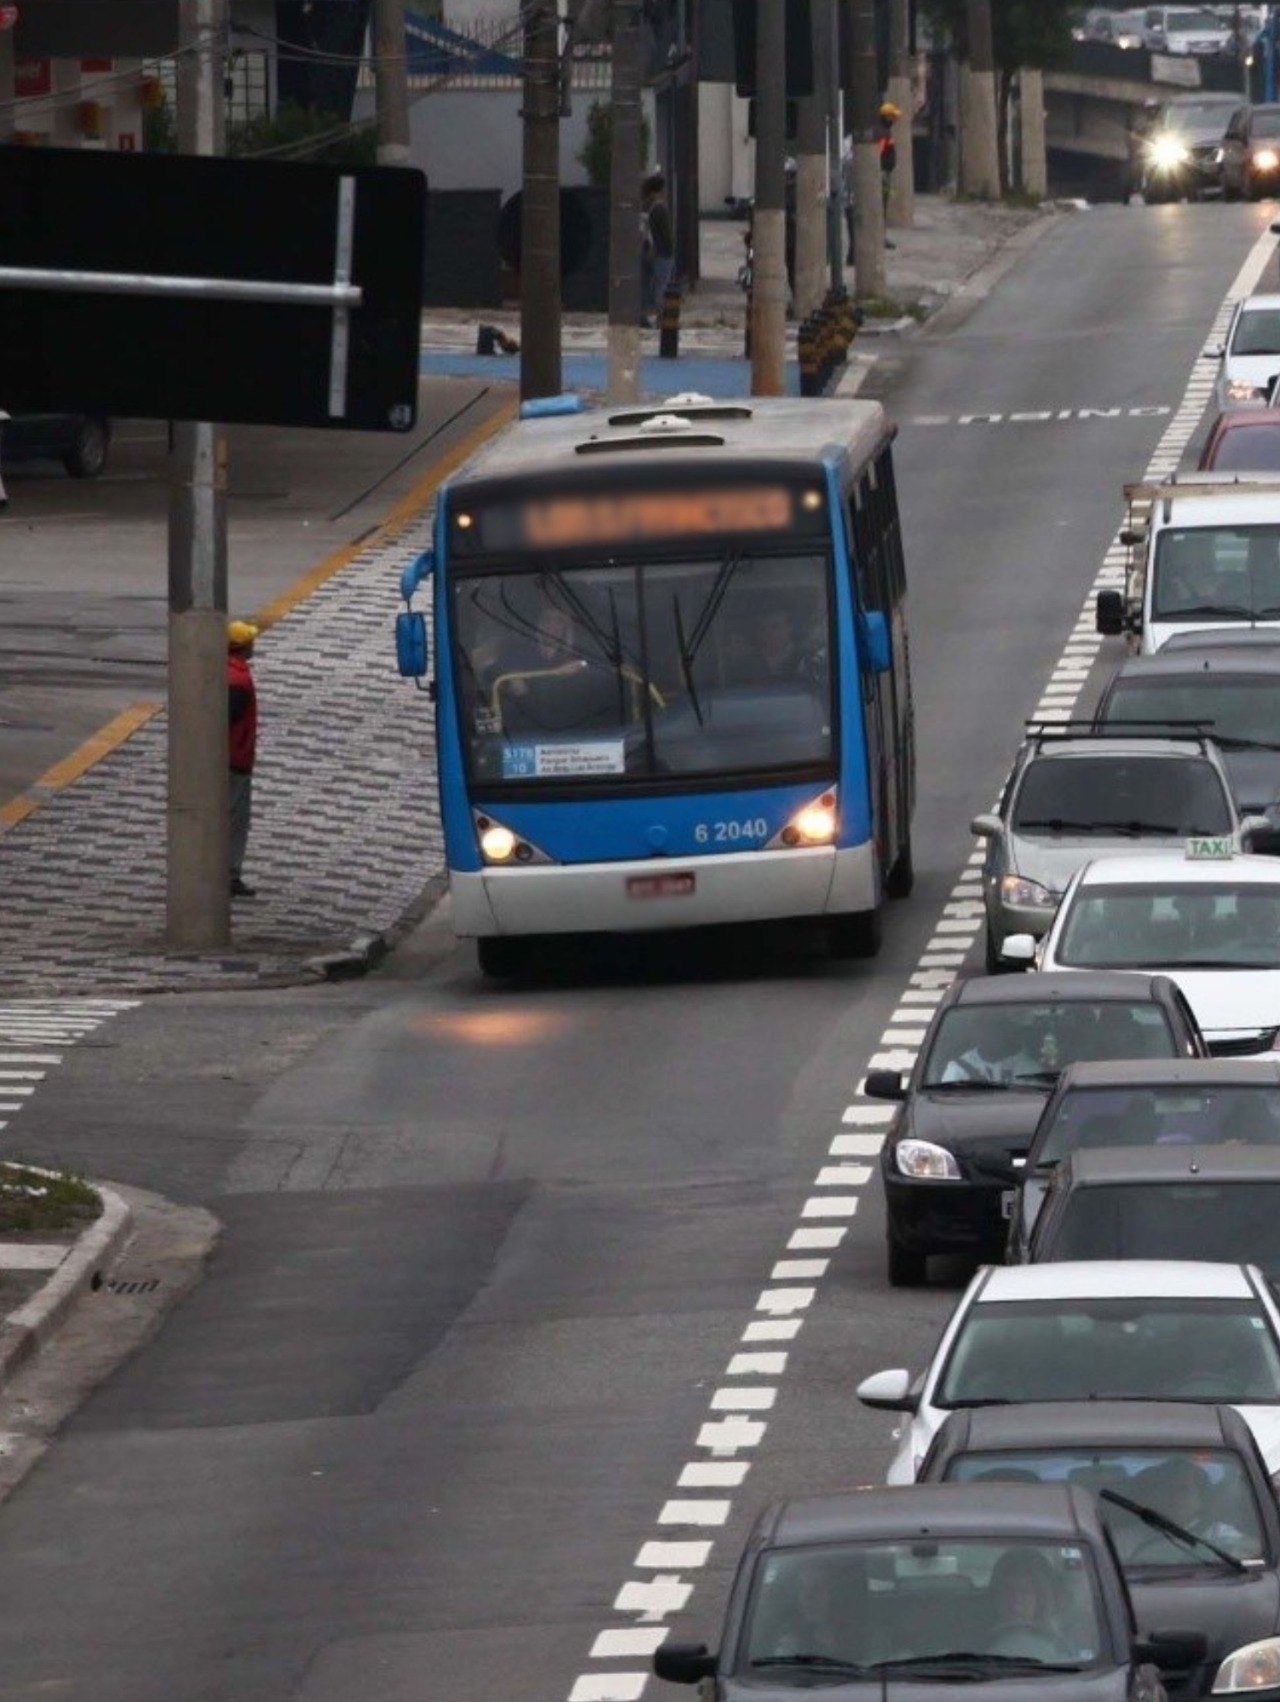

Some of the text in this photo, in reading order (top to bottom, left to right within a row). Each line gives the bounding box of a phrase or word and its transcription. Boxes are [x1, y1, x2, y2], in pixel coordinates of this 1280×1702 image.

[694, 818, 767, 843] 6 2040
[1190, 840, 1228, 856] TAXI
